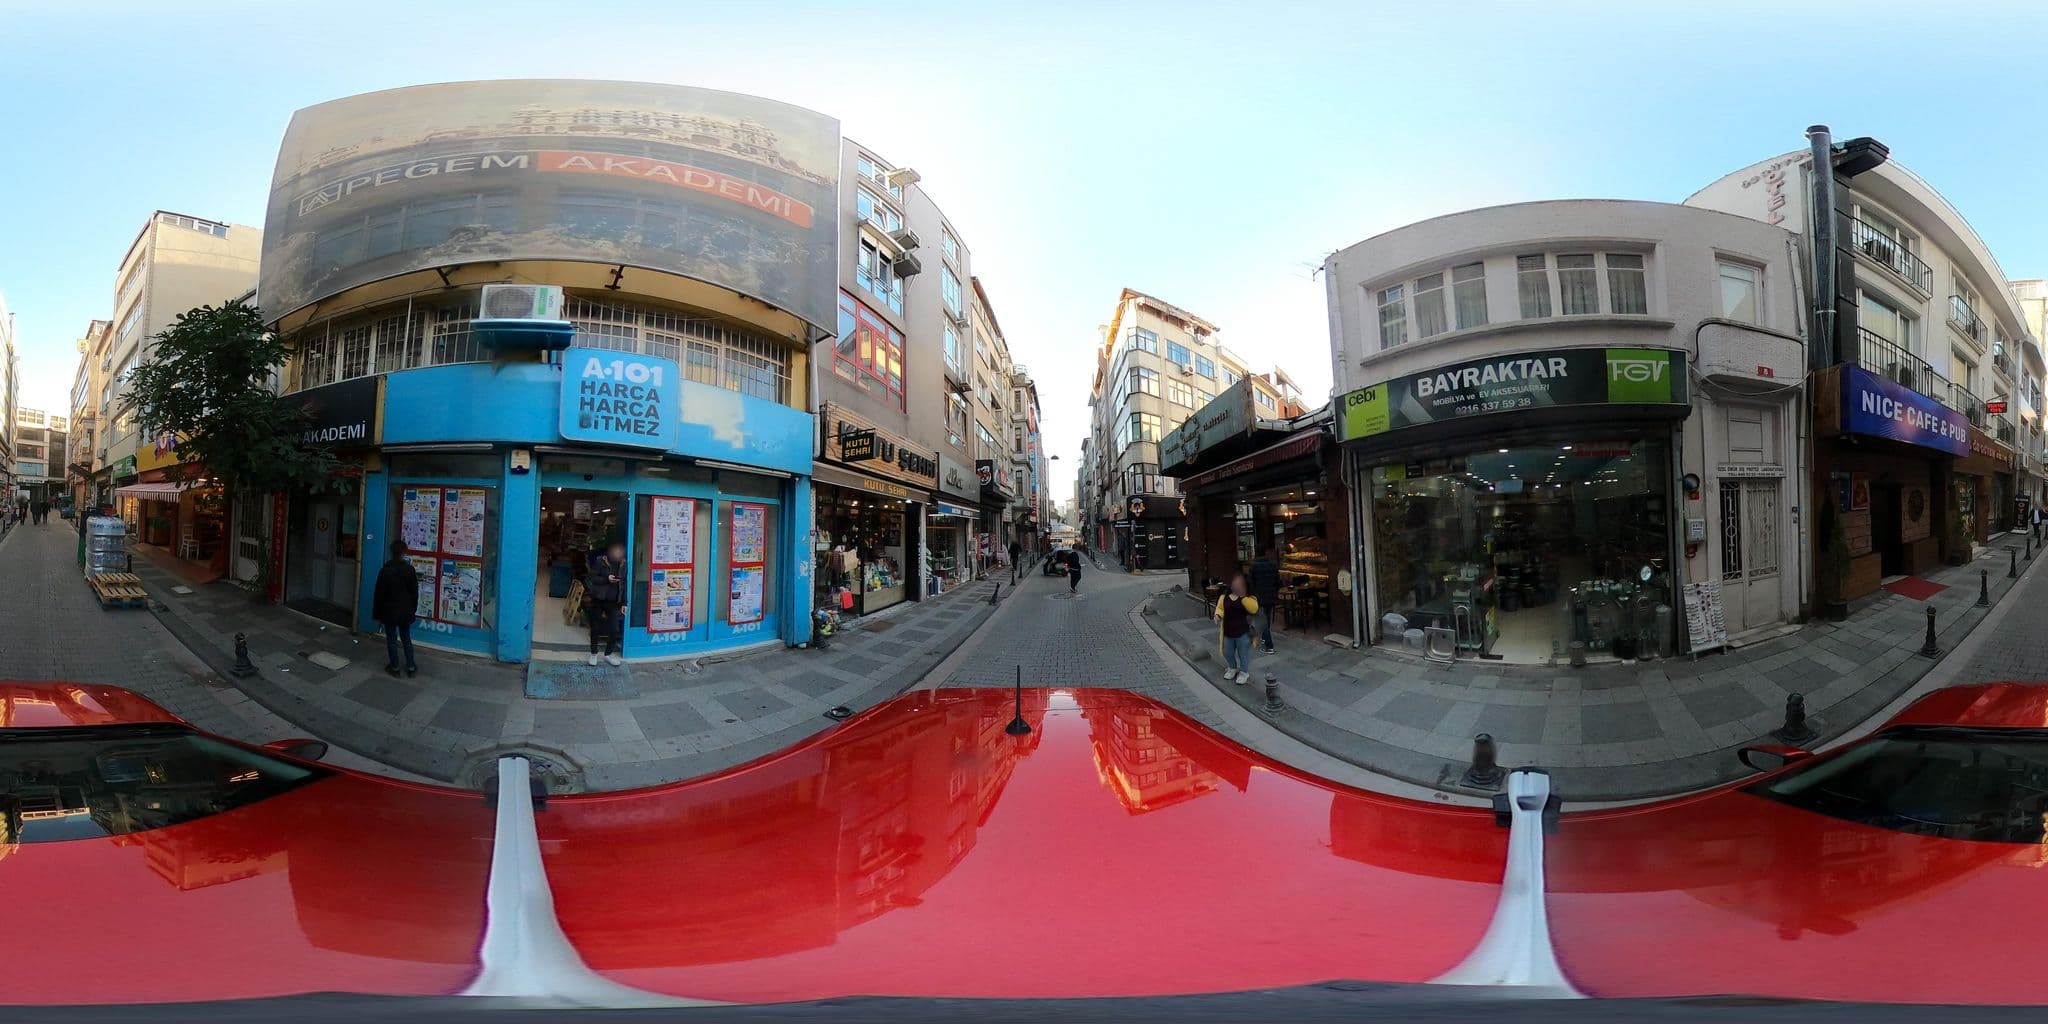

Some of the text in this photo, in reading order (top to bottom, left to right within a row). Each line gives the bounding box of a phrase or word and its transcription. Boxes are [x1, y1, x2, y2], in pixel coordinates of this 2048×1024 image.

[346, 155, 791, 217] PEGEM AKADEMİ
[1417, 357, 1568, 398] BAYRAKTAR
[580, 380, 660, 403] HARCA
[1432, 394, 1465, 407] MOBİLYA
[1479, 390, 1489, 399] EV
[579, 396, 660, 420] HARCA
[1455, 404, 1479, 415] 0216
[1481, 401, 1499, 411] 337
[1518, 398, 1532, 407] 38
[1862, 389, 1966, 443] NICE CAFE & PUB
[303, 420, 366, 444] AKADEMİ
[846, 437, 870, 448] KUTU
[863, 479, 885, 492] KUTU
